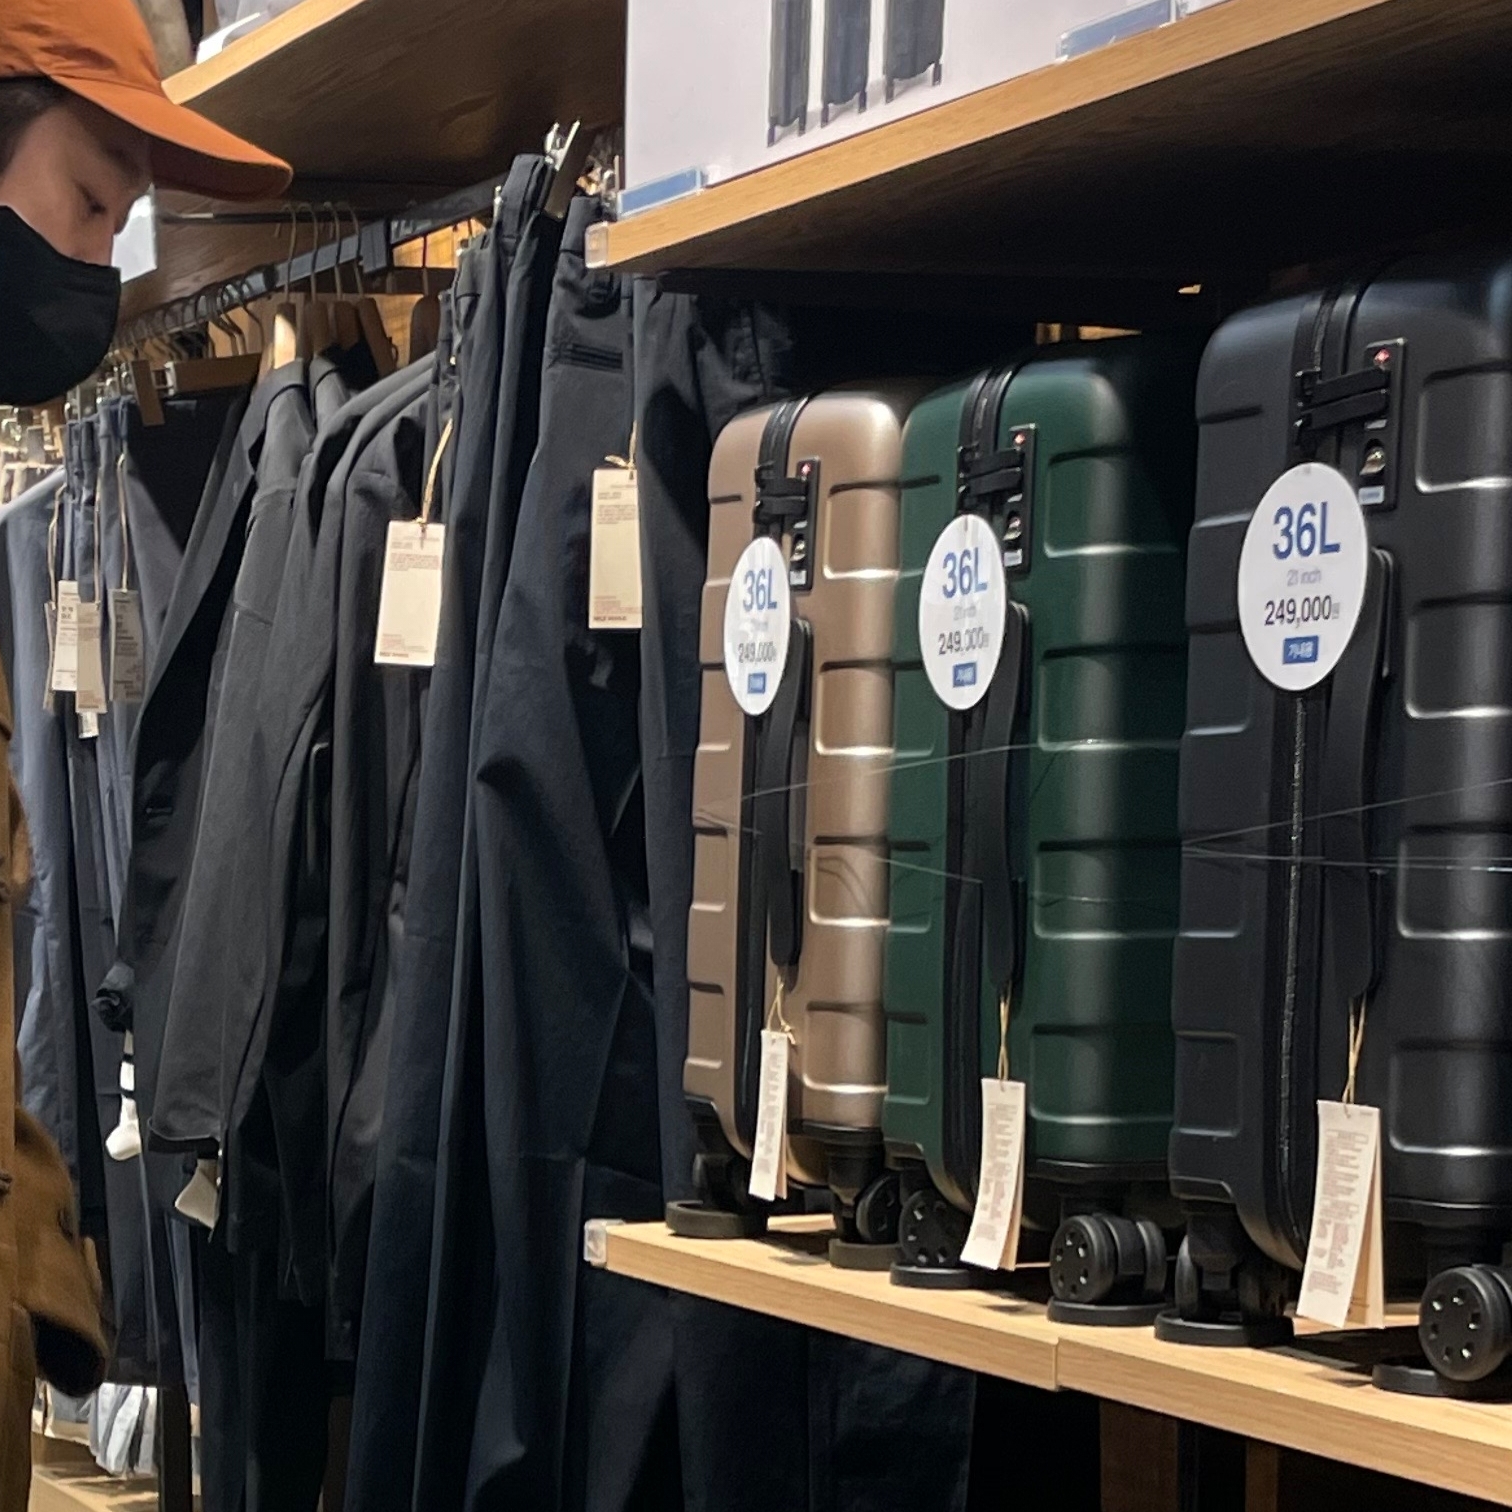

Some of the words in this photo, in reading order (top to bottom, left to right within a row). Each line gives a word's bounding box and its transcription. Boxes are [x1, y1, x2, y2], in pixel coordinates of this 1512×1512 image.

[1273, 501, 1341, 560] 36L
[742, 568, 777, 611] 36L
[942, 547, 988, 599] 36L
[1300, 568, 1321, 585] inch
